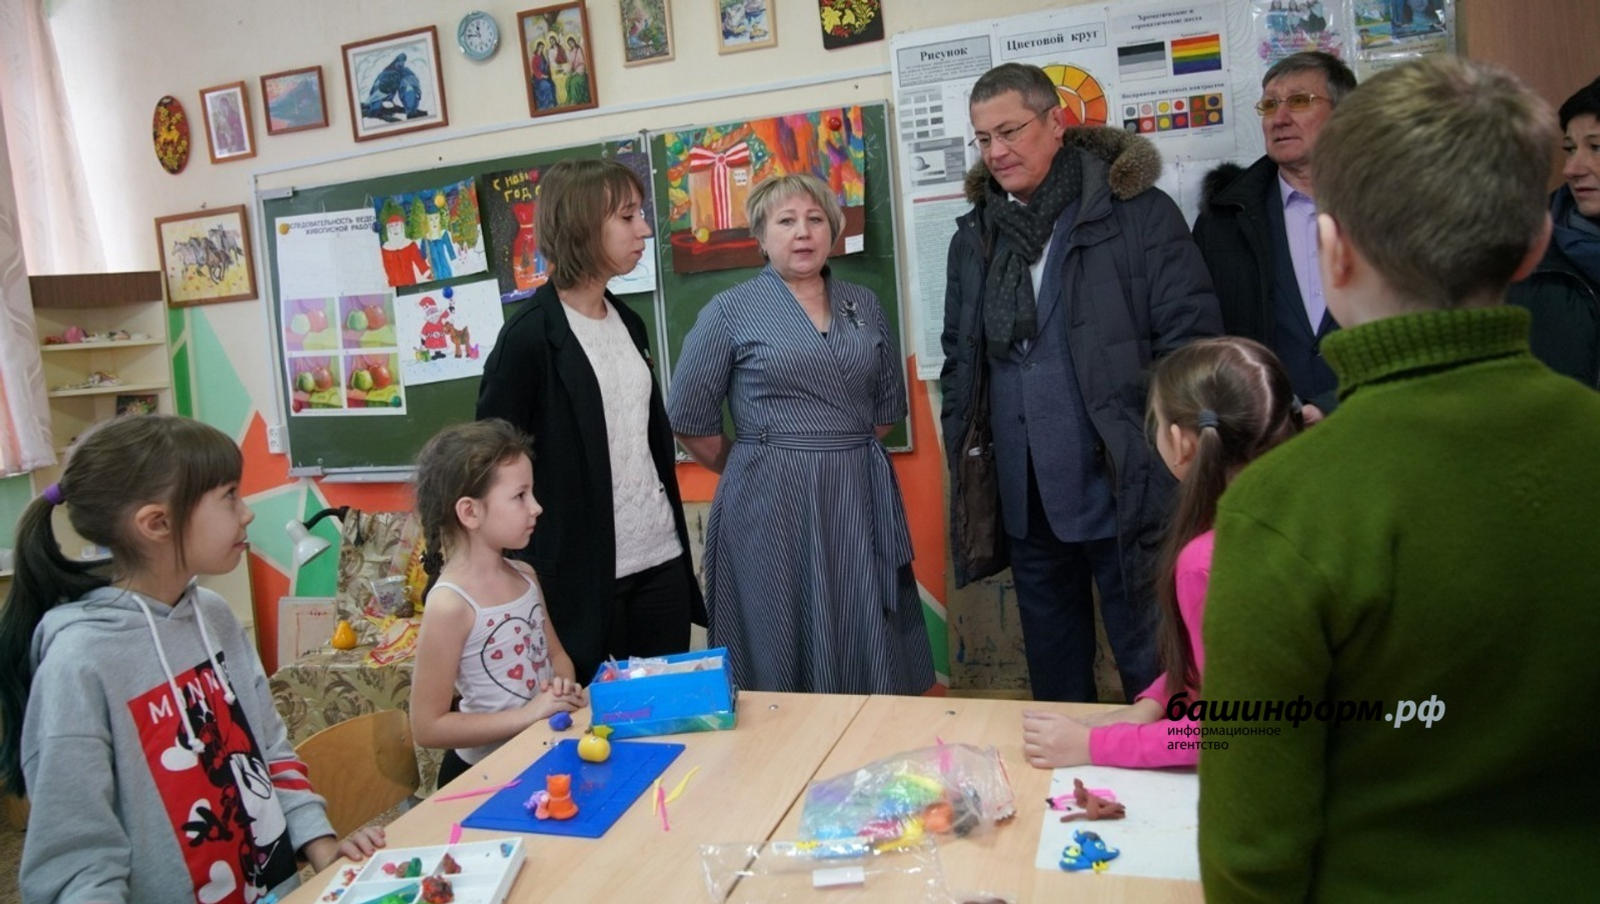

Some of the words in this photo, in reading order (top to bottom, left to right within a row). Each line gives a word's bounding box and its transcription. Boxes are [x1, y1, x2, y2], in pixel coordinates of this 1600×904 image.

[1007, 32, 1064, 51] Цветовой
[1071, 30, 1099, 44] круг
[920, 45, 968, 62] Рисунок
